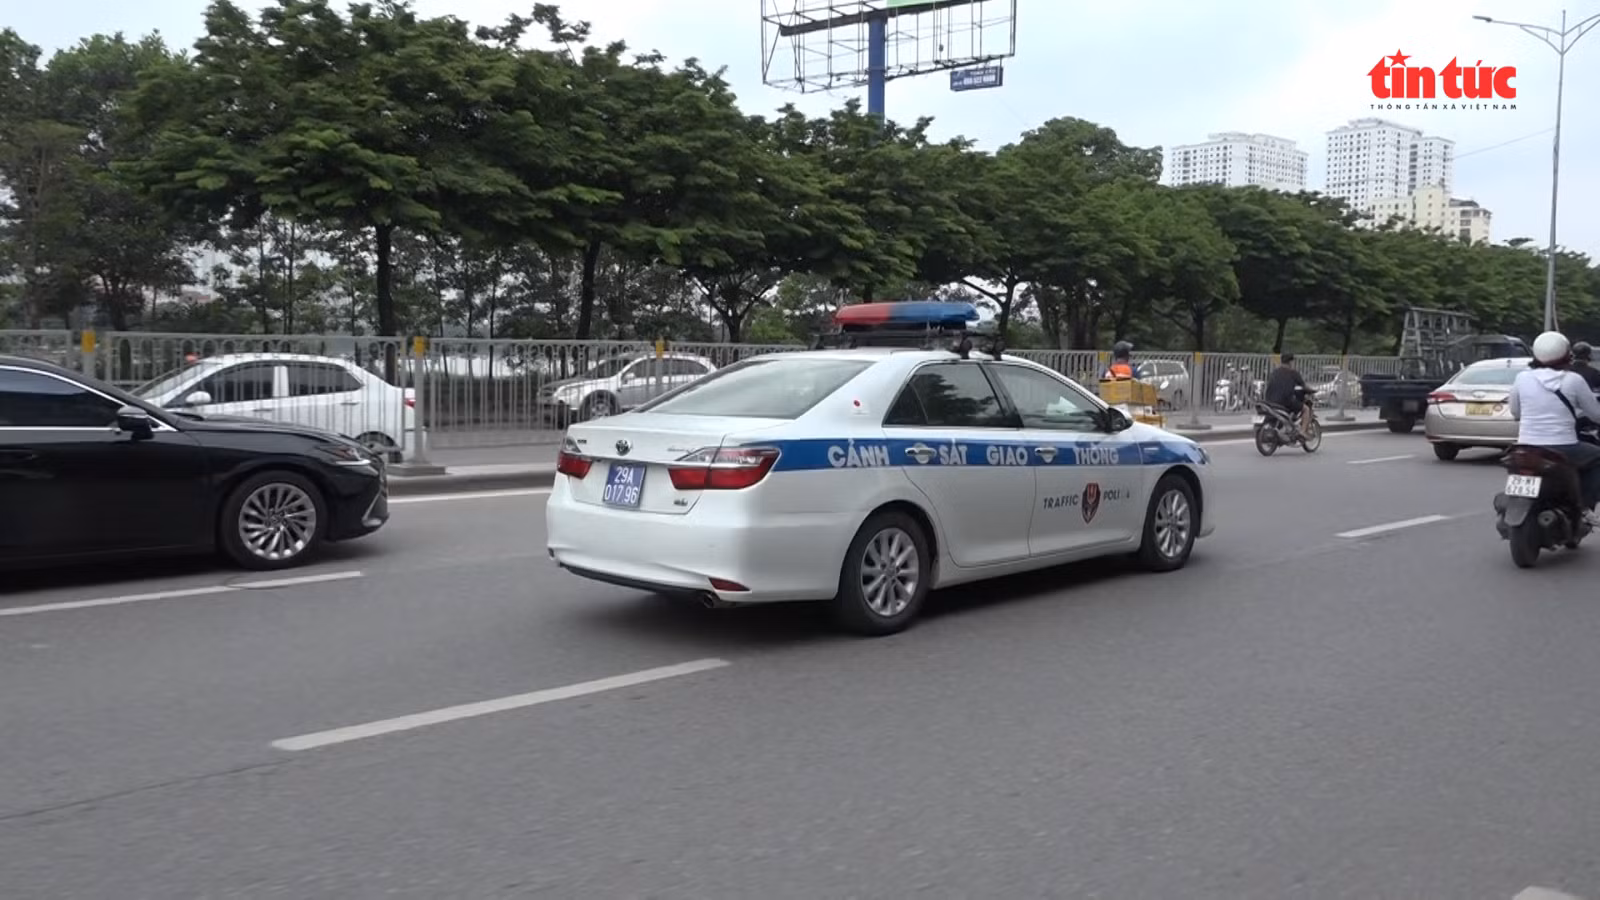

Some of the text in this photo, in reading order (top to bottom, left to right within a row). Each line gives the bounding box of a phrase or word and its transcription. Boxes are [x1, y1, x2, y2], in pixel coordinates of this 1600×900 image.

[827, 438, 890, 468] CẢNH
[986, 445, 1028, 466] GIAO
[1073, 442, 1119, 465] THÔNG
[614, 466, 634, 483] 29A
[1043, 494, 1080, 510] TRAFFIC
